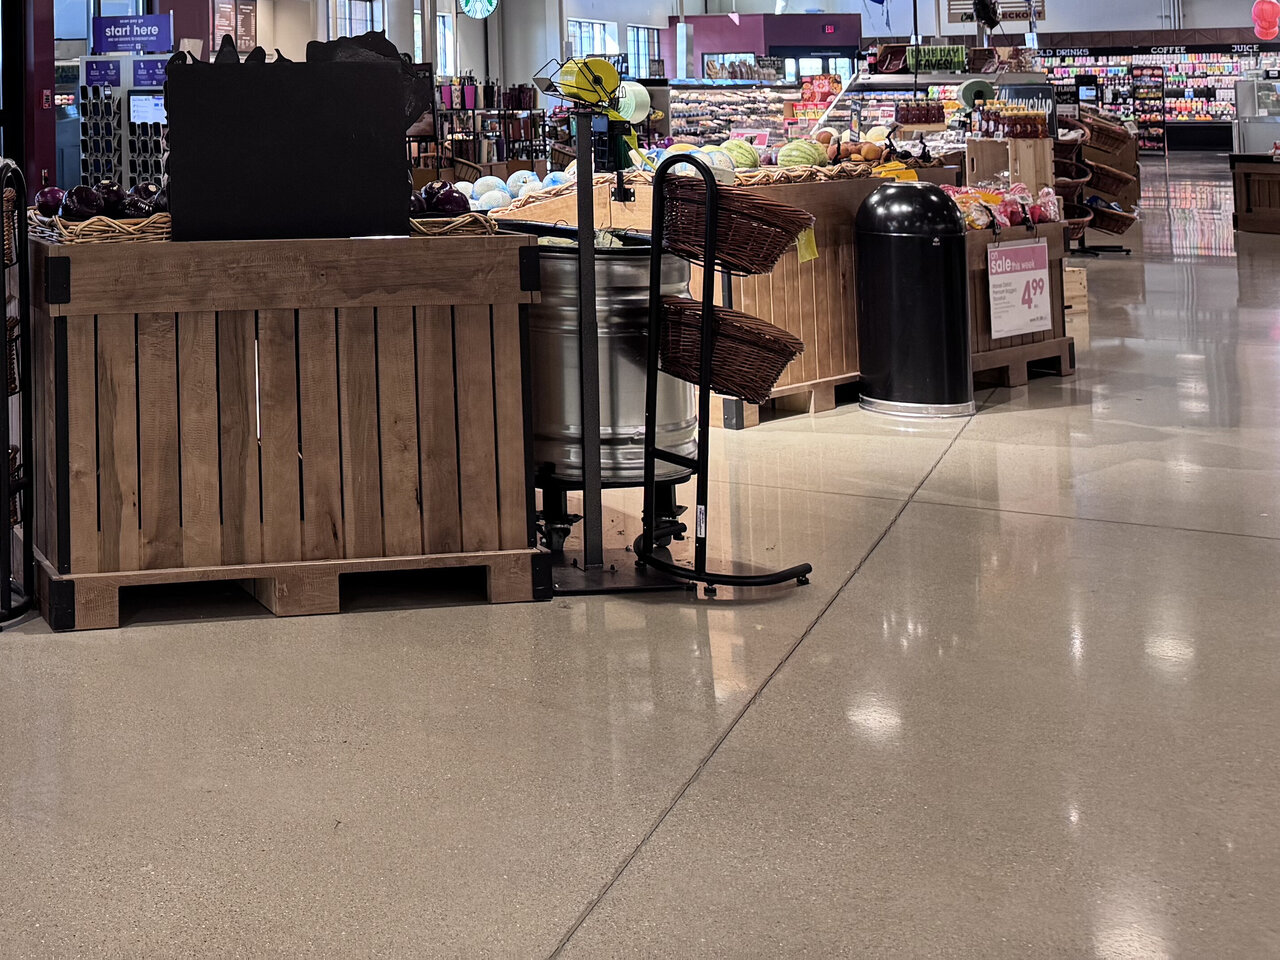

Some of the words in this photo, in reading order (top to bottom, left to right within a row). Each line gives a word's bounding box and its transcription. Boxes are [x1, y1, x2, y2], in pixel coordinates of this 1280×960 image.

[105, 25, 130, 36] start
[133, 24, 159, 35] here
[939, 47, 959, 58] DAY
[1056, 48, 1090, 56] DRINKS
[1151, 46, 1187, 54] COFFEE
[1231, 44, 1260, 52] JUICE
[990, 251, 999, 260] on
[991, 256, 1012, 273] sale
[1012, 261, 1021, 271] this
[1021, 259, 1035, 269] week
